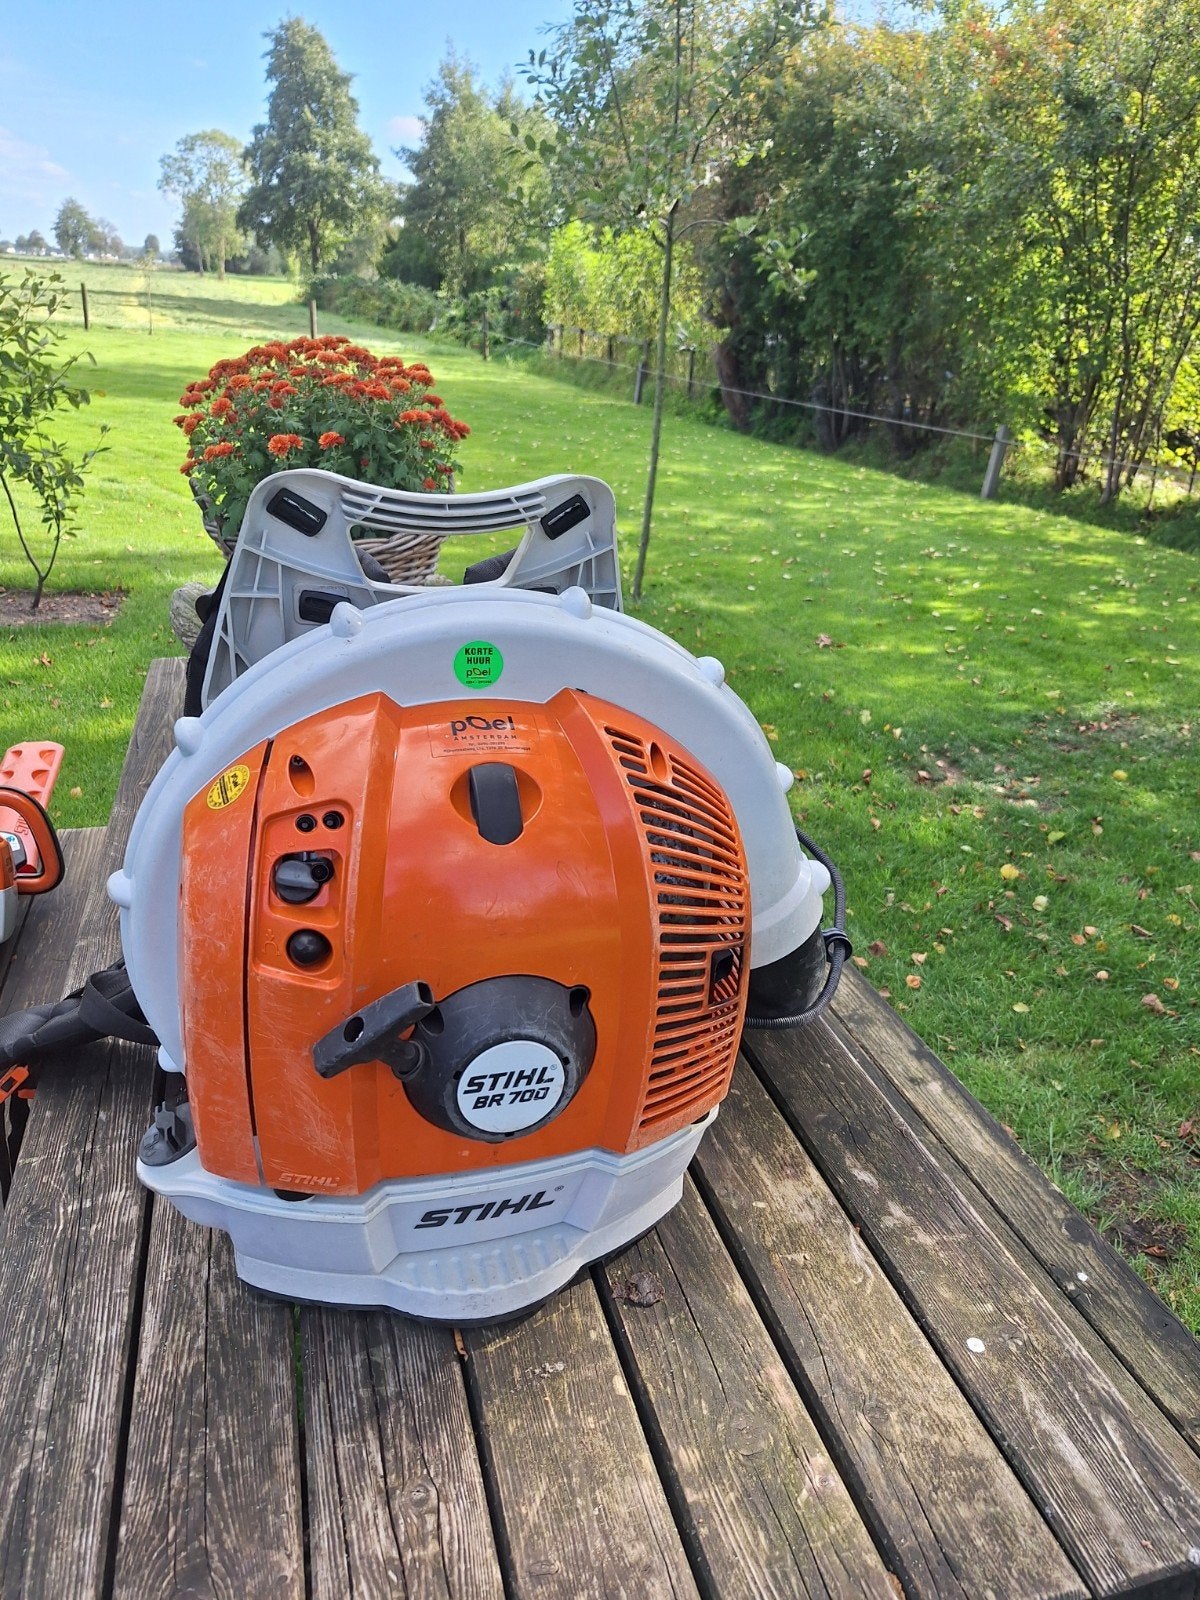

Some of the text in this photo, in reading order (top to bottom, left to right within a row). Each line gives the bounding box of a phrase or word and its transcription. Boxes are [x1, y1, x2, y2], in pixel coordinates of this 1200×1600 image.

[464, 647, 493, 656] KORTE
[466, 656, 491, 665] HUUR
[463, 1066, 555, 1095] STIHL
[472, 1087, 550, 1110] BR 700
[279, 1172, 338, 1188] STIHL
[414, 1190, 555, 1229] STIHL
